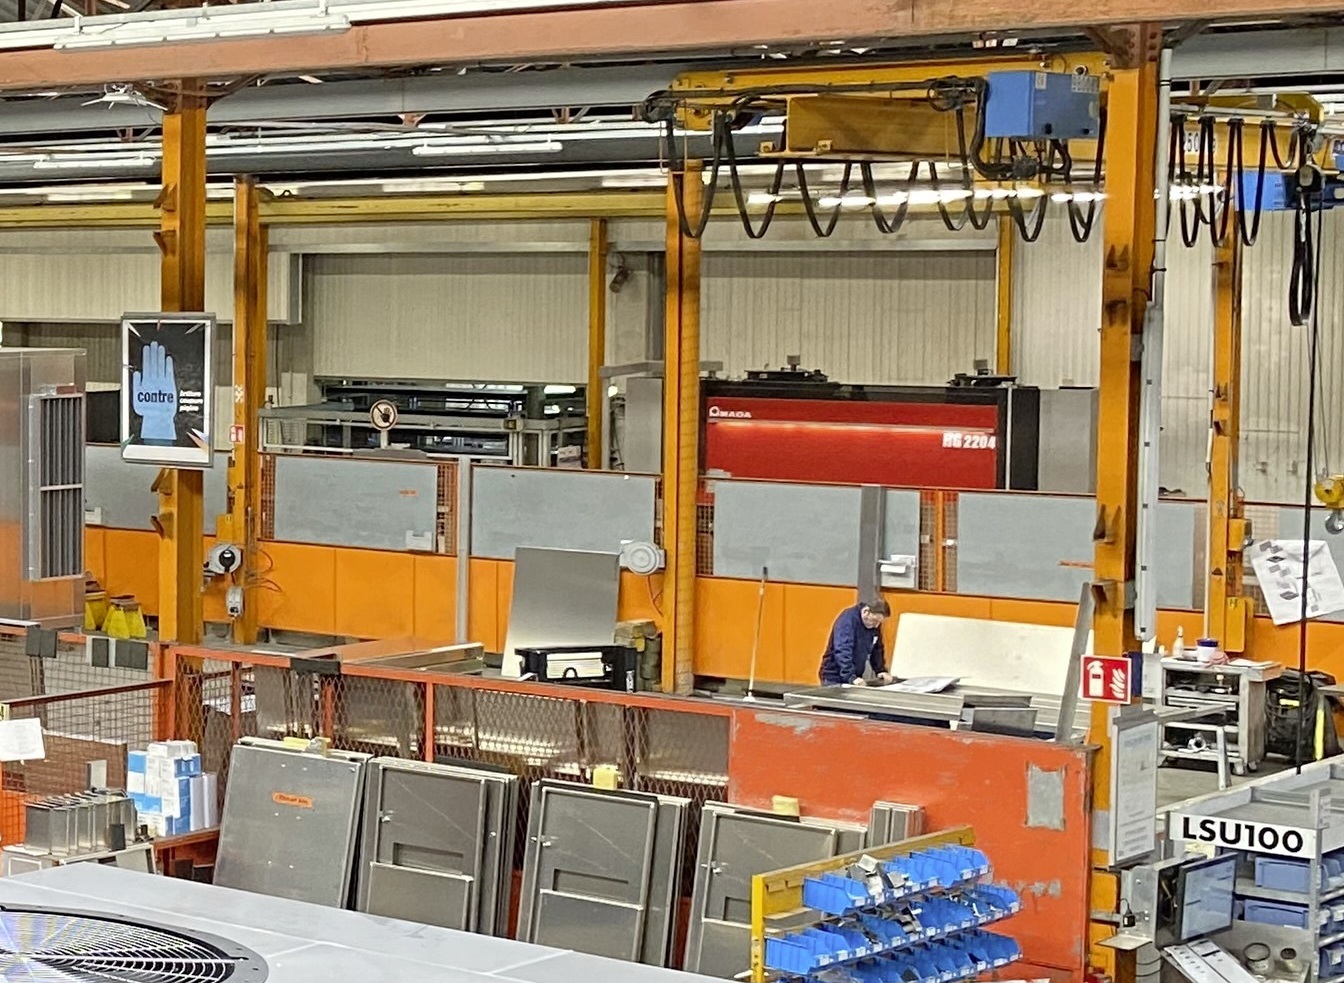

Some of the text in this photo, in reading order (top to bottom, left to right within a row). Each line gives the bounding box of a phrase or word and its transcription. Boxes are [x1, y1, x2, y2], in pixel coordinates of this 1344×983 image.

[137, 390, 174, 403] contre
[963, 434, 997, 450] 2204
[1182, 816, 1304, 853] LSU100
